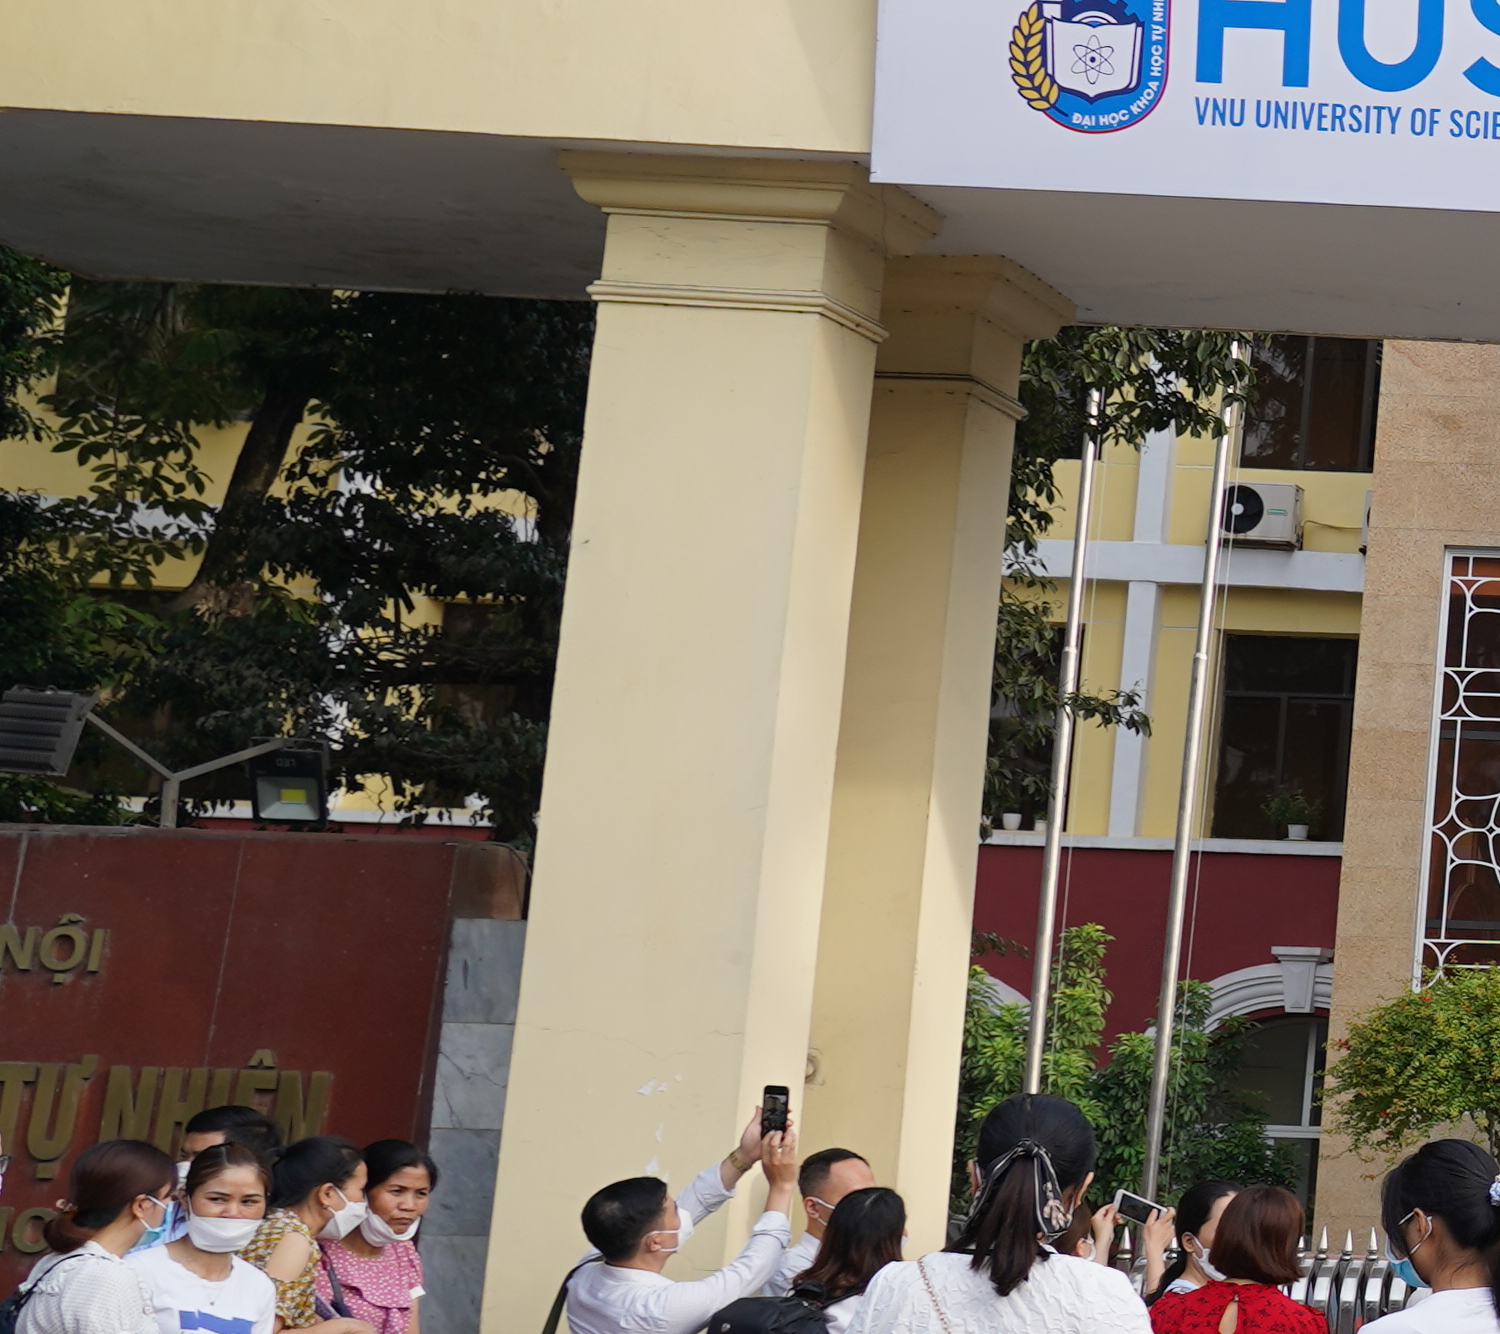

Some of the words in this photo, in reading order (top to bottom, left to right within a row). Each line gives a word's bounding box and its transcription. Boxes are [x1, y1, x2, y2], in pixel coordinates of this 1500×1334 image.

[1151, 24, 1166, 42] TỰ
[1150, 44, 1165, 77] HỌC
[1129, 81, 1160, 115] KHOA
[1072, 111, 1095, 129] ĐẠI
[1099, 109, 1130, 128] HỌC
[1195, 96, 1246, 127] VNU
[1255, 99, 1402, 135] UNIVERSITY
[1410, 107, 1441, 137] OF
[0, 913, 104, 985] NỘI
